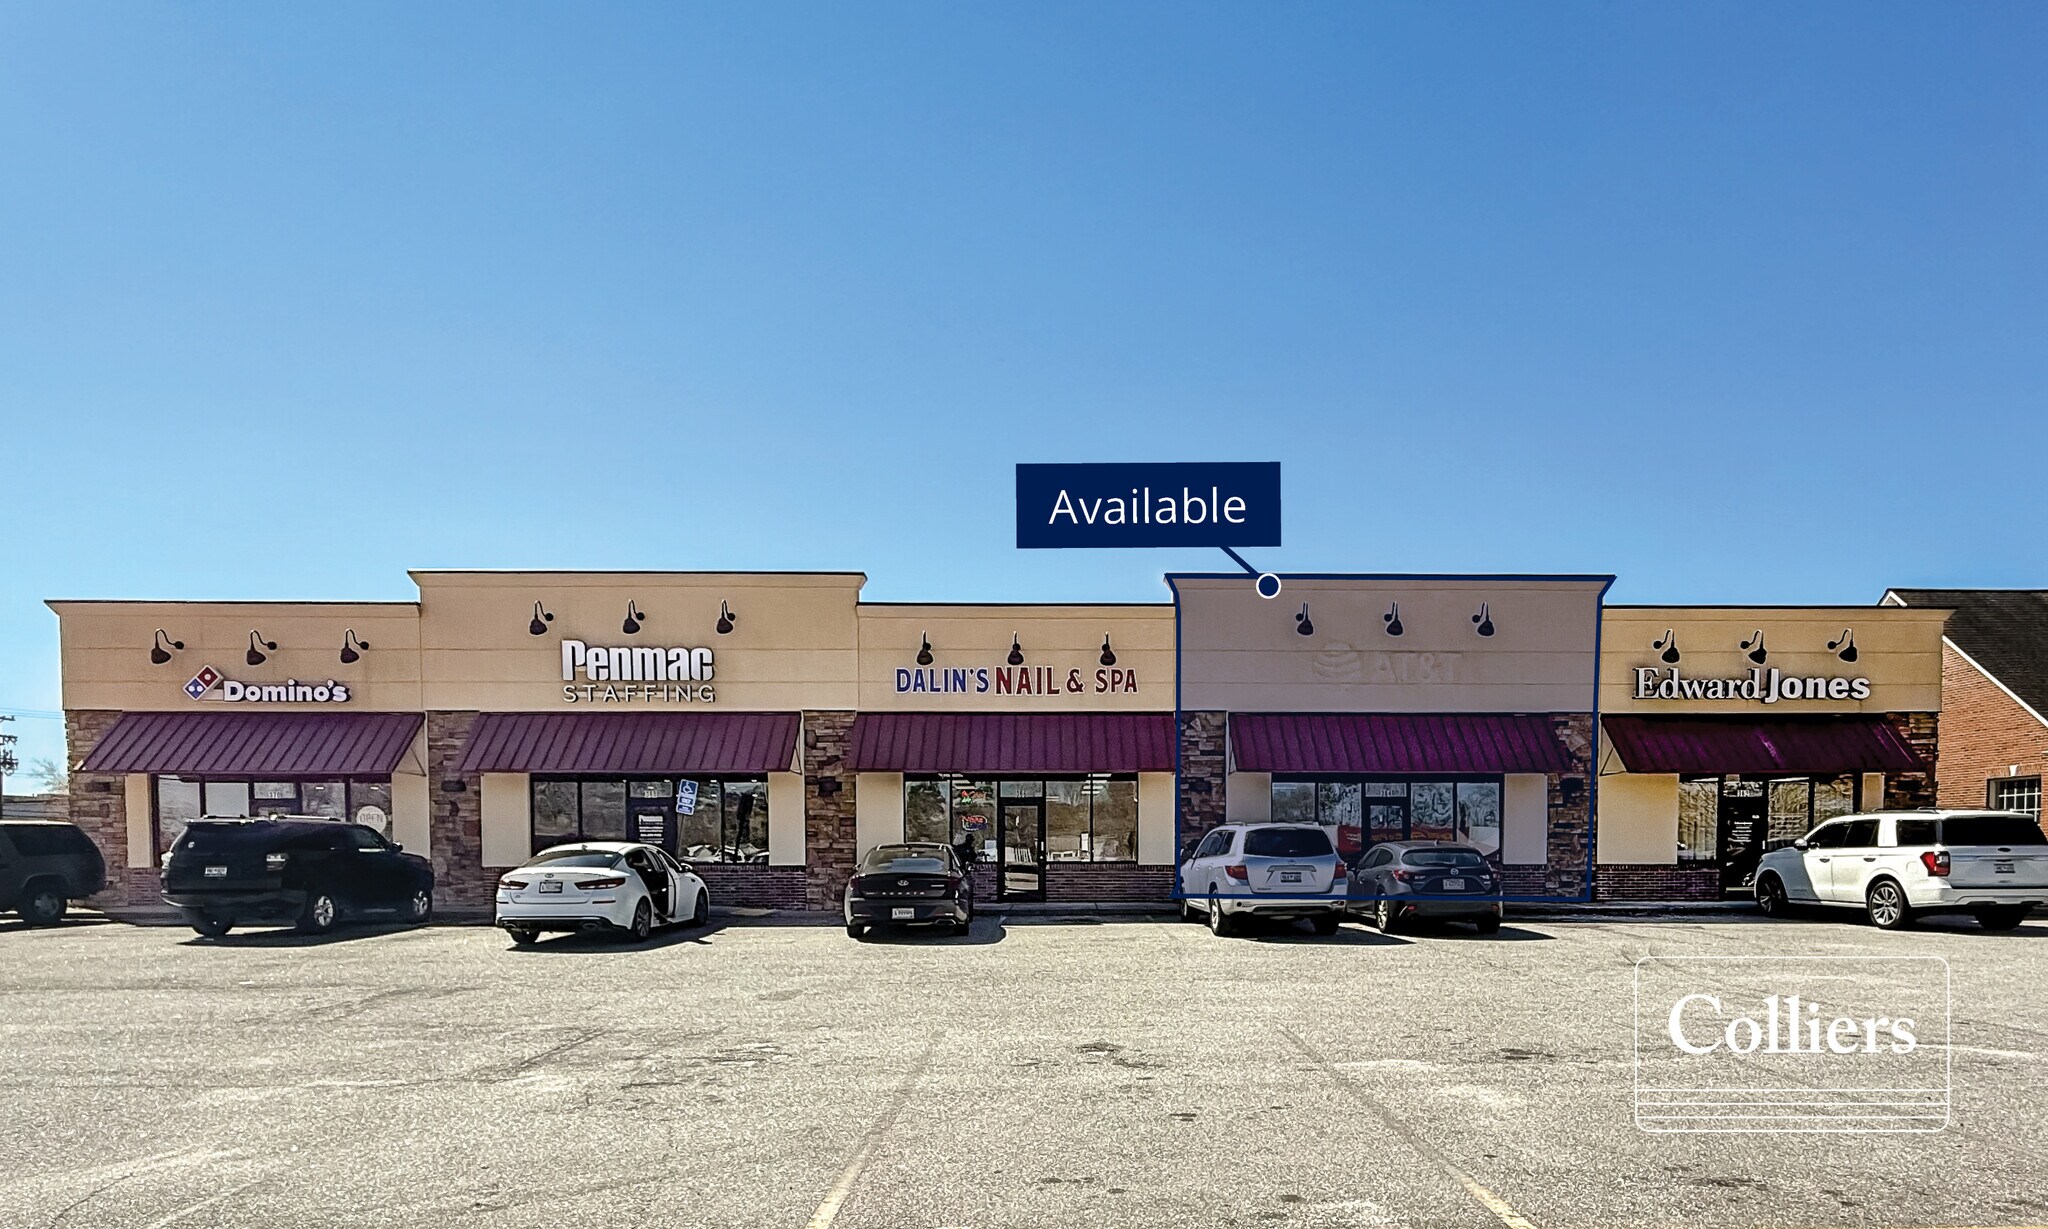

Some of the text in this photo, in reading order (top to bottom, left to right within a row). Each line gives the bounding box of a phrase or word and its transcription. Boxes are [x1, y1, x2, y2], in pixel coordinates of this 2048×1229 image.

[561, 639, 714, 681] Penmac
[223, 679, 350, 702] Domino's
[562, 684, 716, 703] STAFFING
[895, 666, 1138, 695] DALIN'S NAIL & SPA
[1633, 667, 1871, 704] Edward Jones
